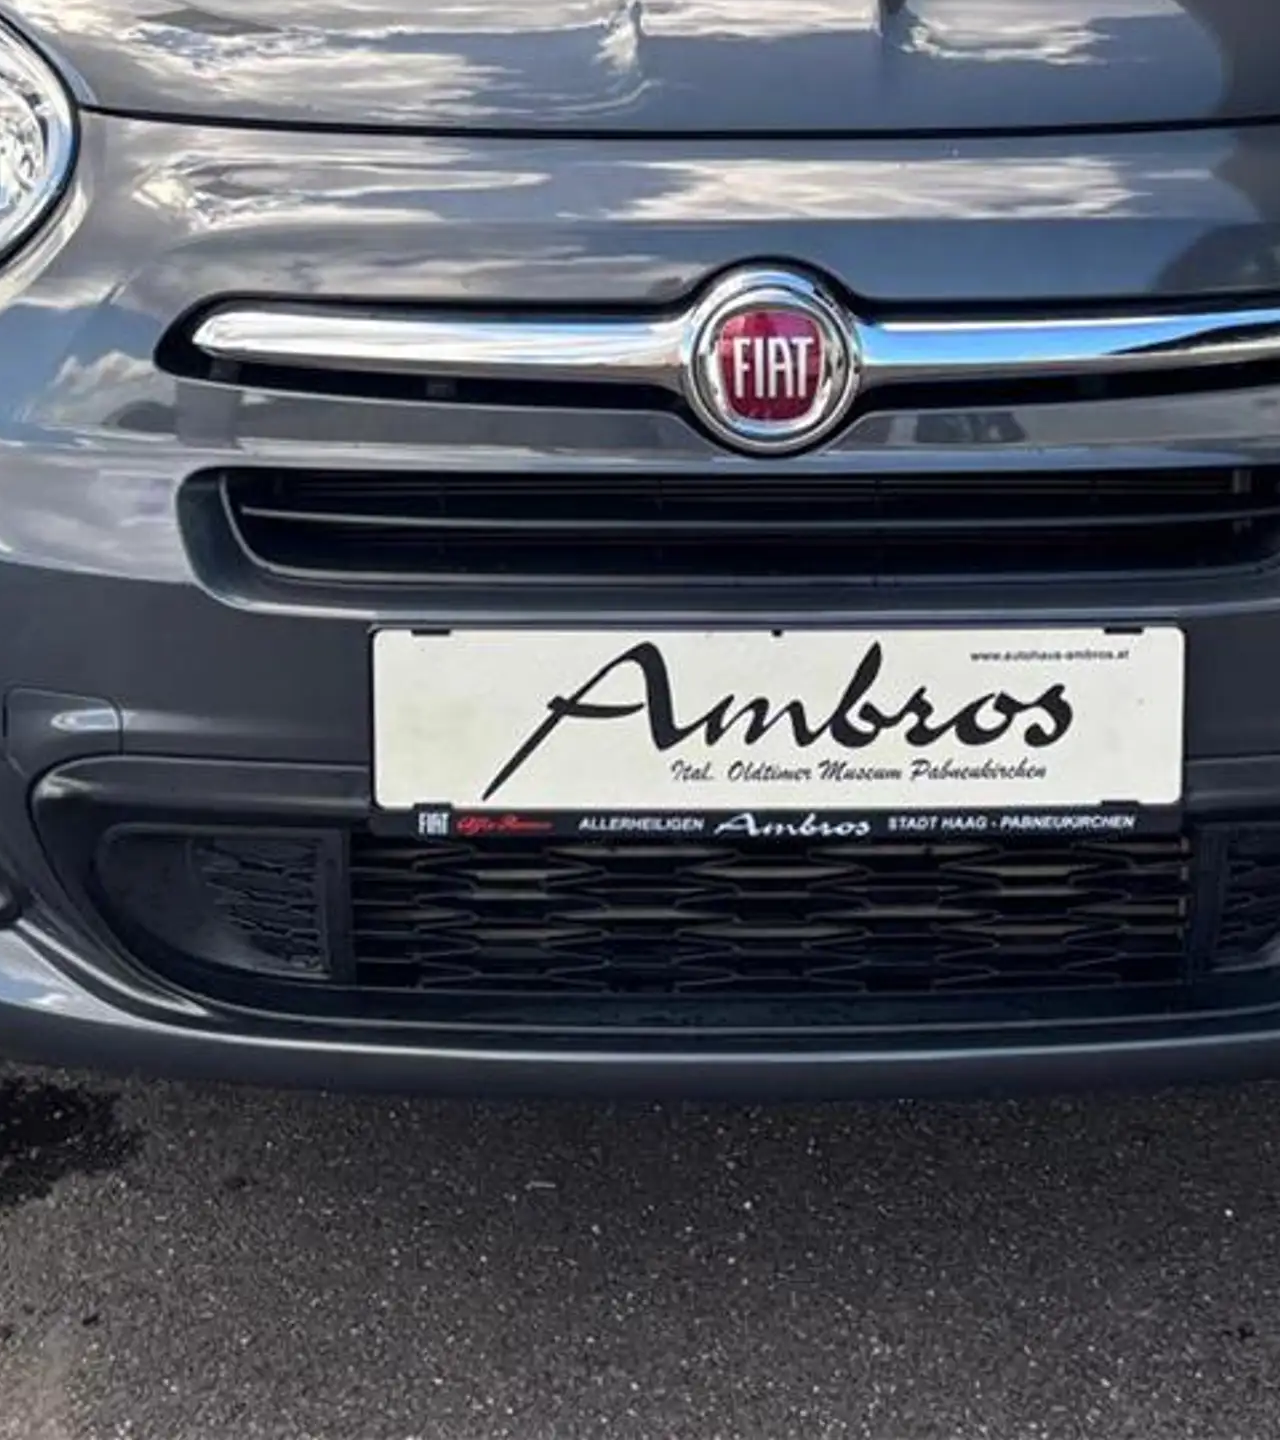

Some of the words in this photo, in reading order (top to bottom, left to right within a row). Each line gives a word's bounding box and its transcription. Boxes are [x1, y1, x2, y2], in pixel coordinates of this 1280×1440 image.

[732, 335, 815, 399] FIAT
[482, 641, 1074, 801] Ambros
[670, 759, 714, 782] Ital.
[726, 758, 813, 782] Oldtimer
[818, 759, 903, 782] Museum
[417, 812, 450, 836] FIAT
[578, 816, 706, 833] ALLERHEILIGEN
[714, 812, 871, 837] Ambros
[888, 815, 939, 832] STADT
[941, 815, 989, 832] HAAG
[999, 813, 1136, 831] PABNEUKIRCHEN
